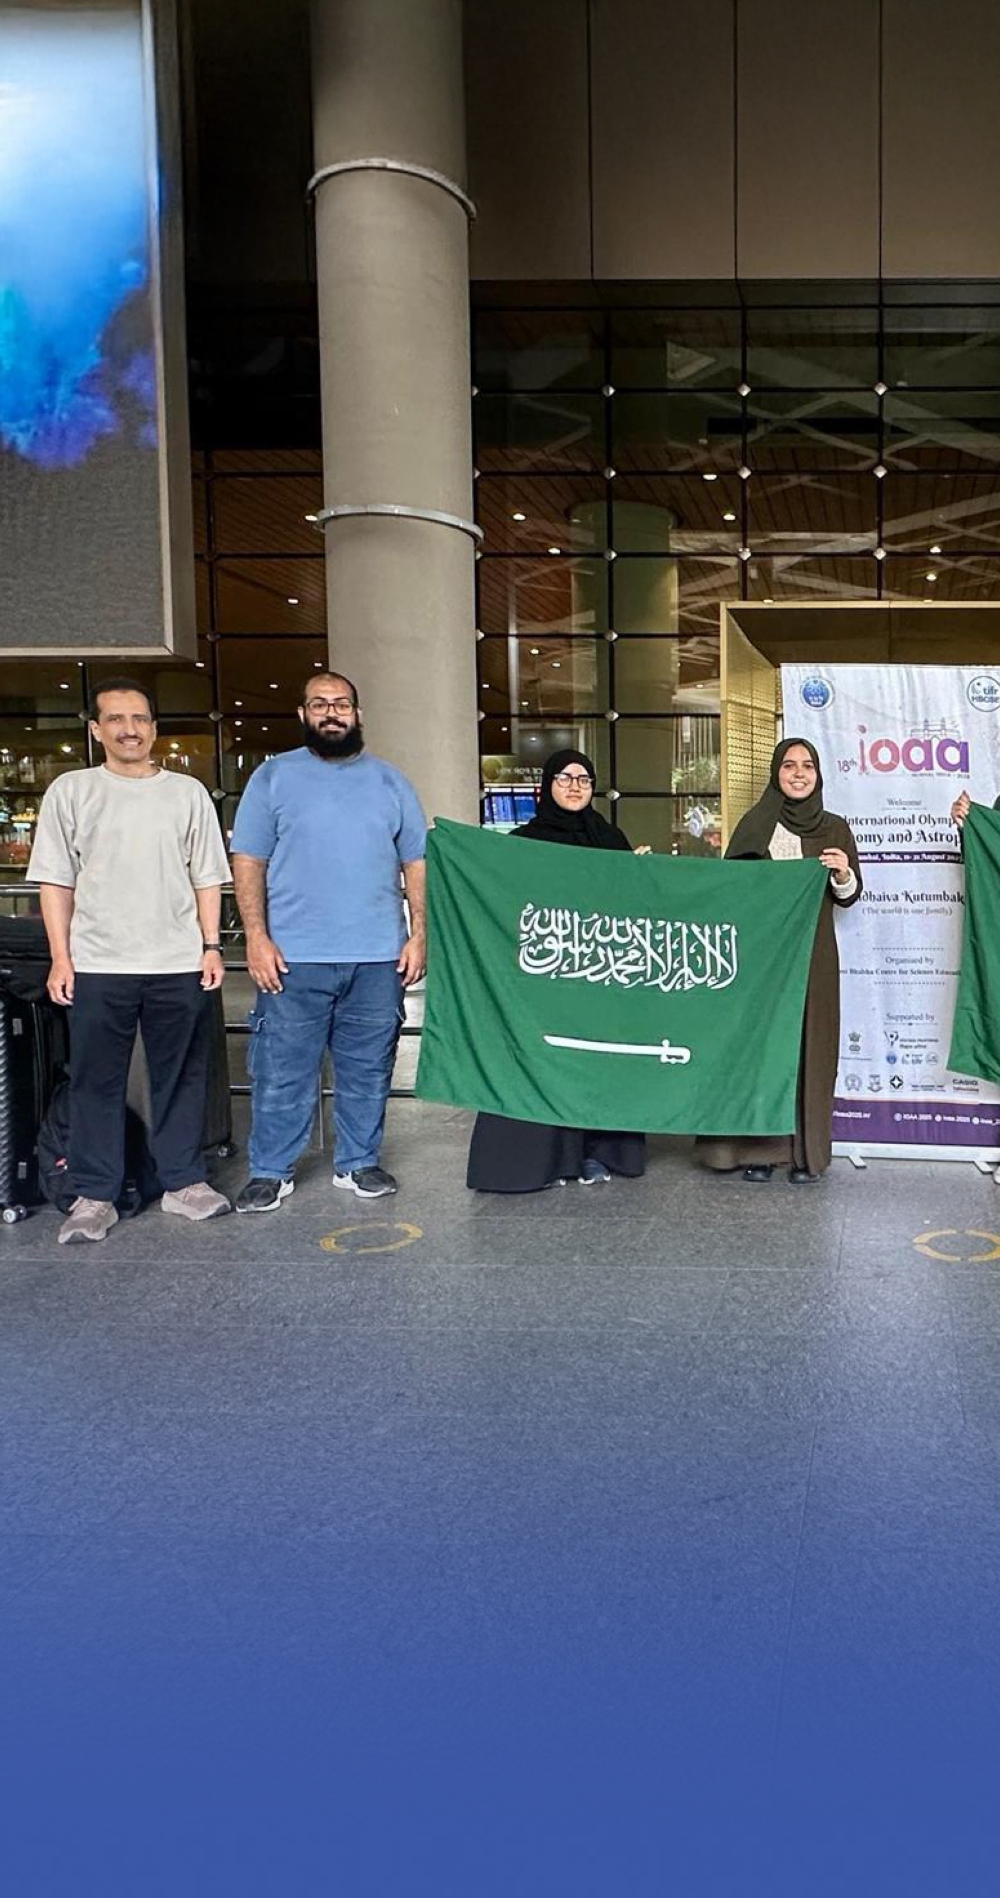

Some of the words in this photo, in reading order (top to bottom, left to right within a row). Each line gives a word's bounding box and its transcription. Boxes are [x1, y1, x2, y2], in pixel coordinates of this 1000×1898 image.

[858, 725, 970, 773] ioaa
[837, 758, 857, 773] 18th
[886, 798, 921, 807] Welcome
[919, 813, 956, 828] Olymp
[888, 829, 913, 843] and
[914, 829, 961, 847] Astrop
[861, 890, 899, 903] dhaiva
[901, 890, 965, 905] Kutumbak
[925, 956, 935, 966] by
[886, 1012, 923, 1022] Supported
[925, 1012, 935, 1022] by
[953, 1078, 979, 1086] CASIO
